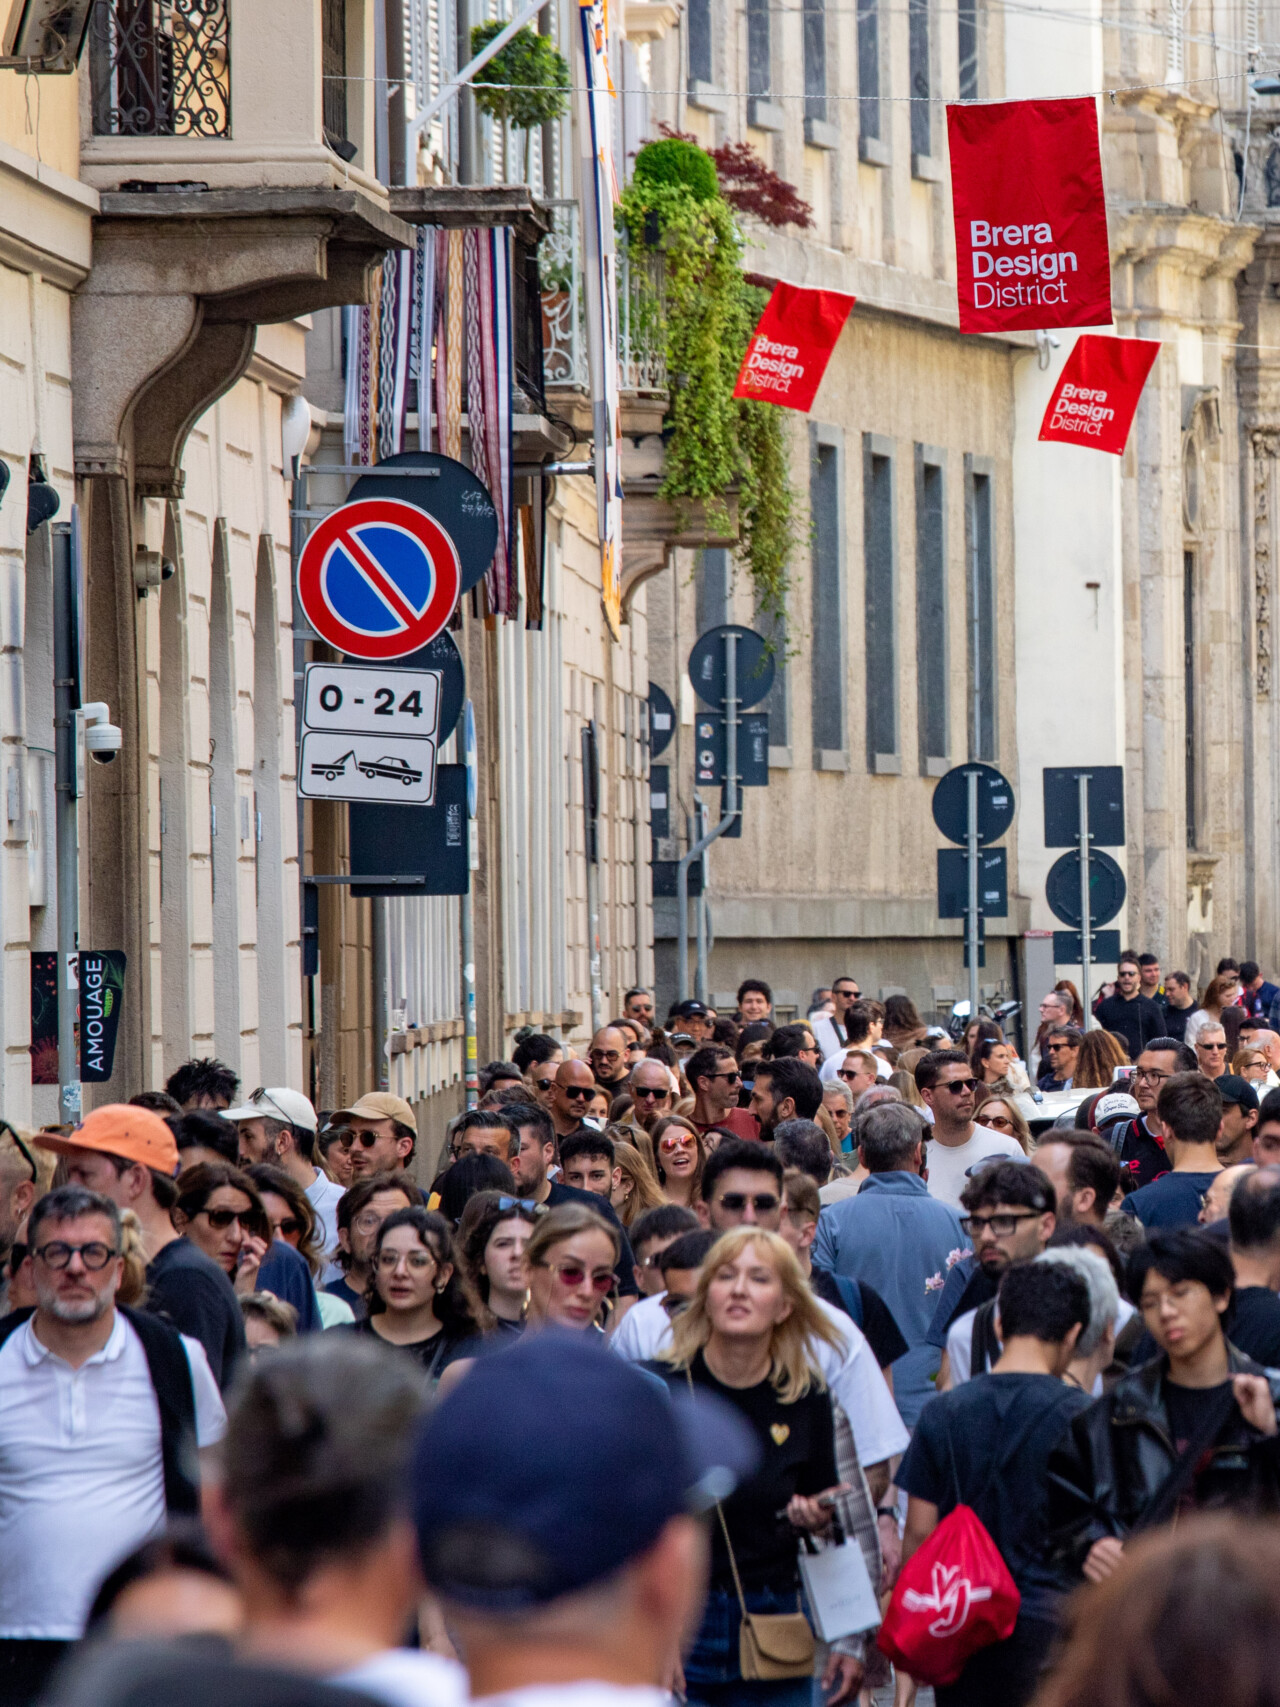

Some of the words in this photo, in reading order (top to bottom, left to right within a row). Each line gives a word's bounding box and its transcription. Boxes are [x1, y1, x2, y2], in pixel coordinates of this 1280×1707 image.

[970, 220, 1053, 248] Brera
[972, 248, 1078, 280] Design
[973, 278, 1069, 309] District
[753, 337, 799, 360] Brera
[748, 352, 805, 379] Design
[742, 368, 792, 394] District
[1060, 383, 1108, 403] Brera
[1054, 398, 1115, 422] Design
[1049, 413, 1104, 437] District
[319, 684, 343, 712] 0
[353, 697, 365, 705] -
[374, 687, 423, 718] 24
[85, 959, 105, 1072] AMOUAGE
